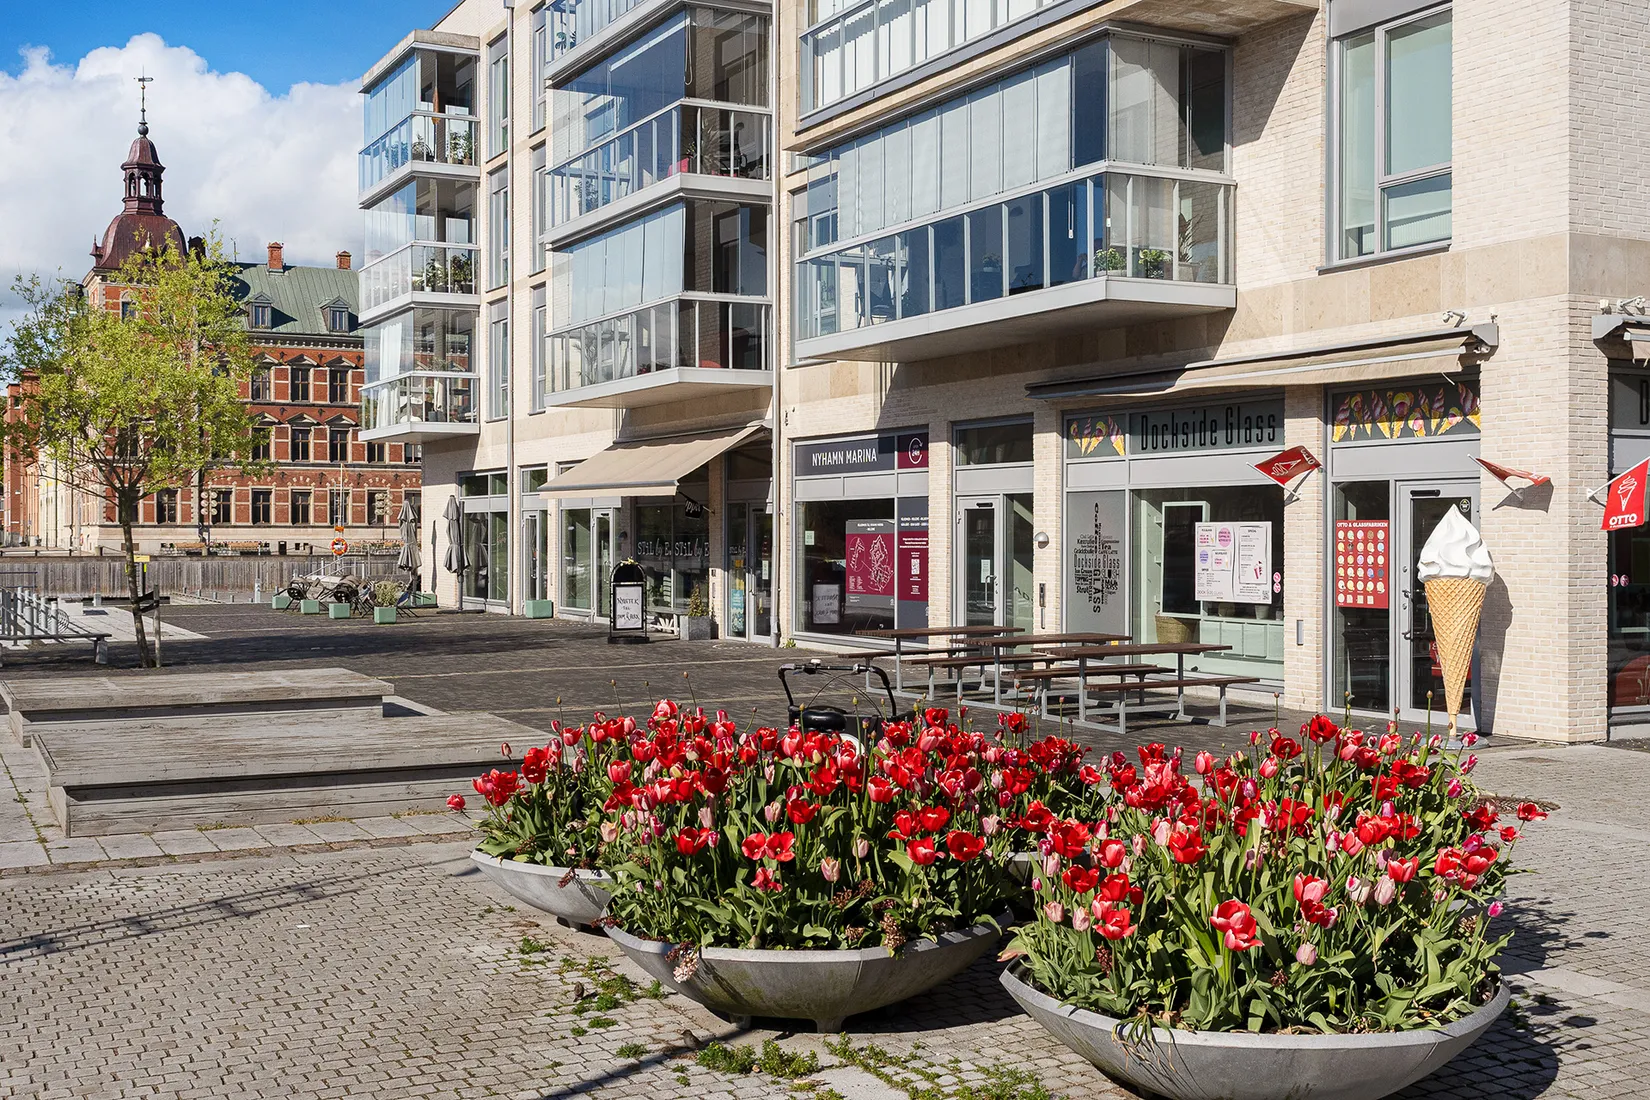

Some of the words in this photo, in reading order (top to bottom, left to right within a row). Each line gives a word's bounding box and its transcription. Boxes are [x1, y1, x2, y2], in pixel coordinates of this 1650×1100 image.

[1141, 409, 1217, 450] Dockside
[1226, 406, 1275, 445] Glass
[812, 450, 844, 466] NYHAMN
[846, 448, 877, 464] MARINA
[1609, 513, 1637, 526] OTTO
